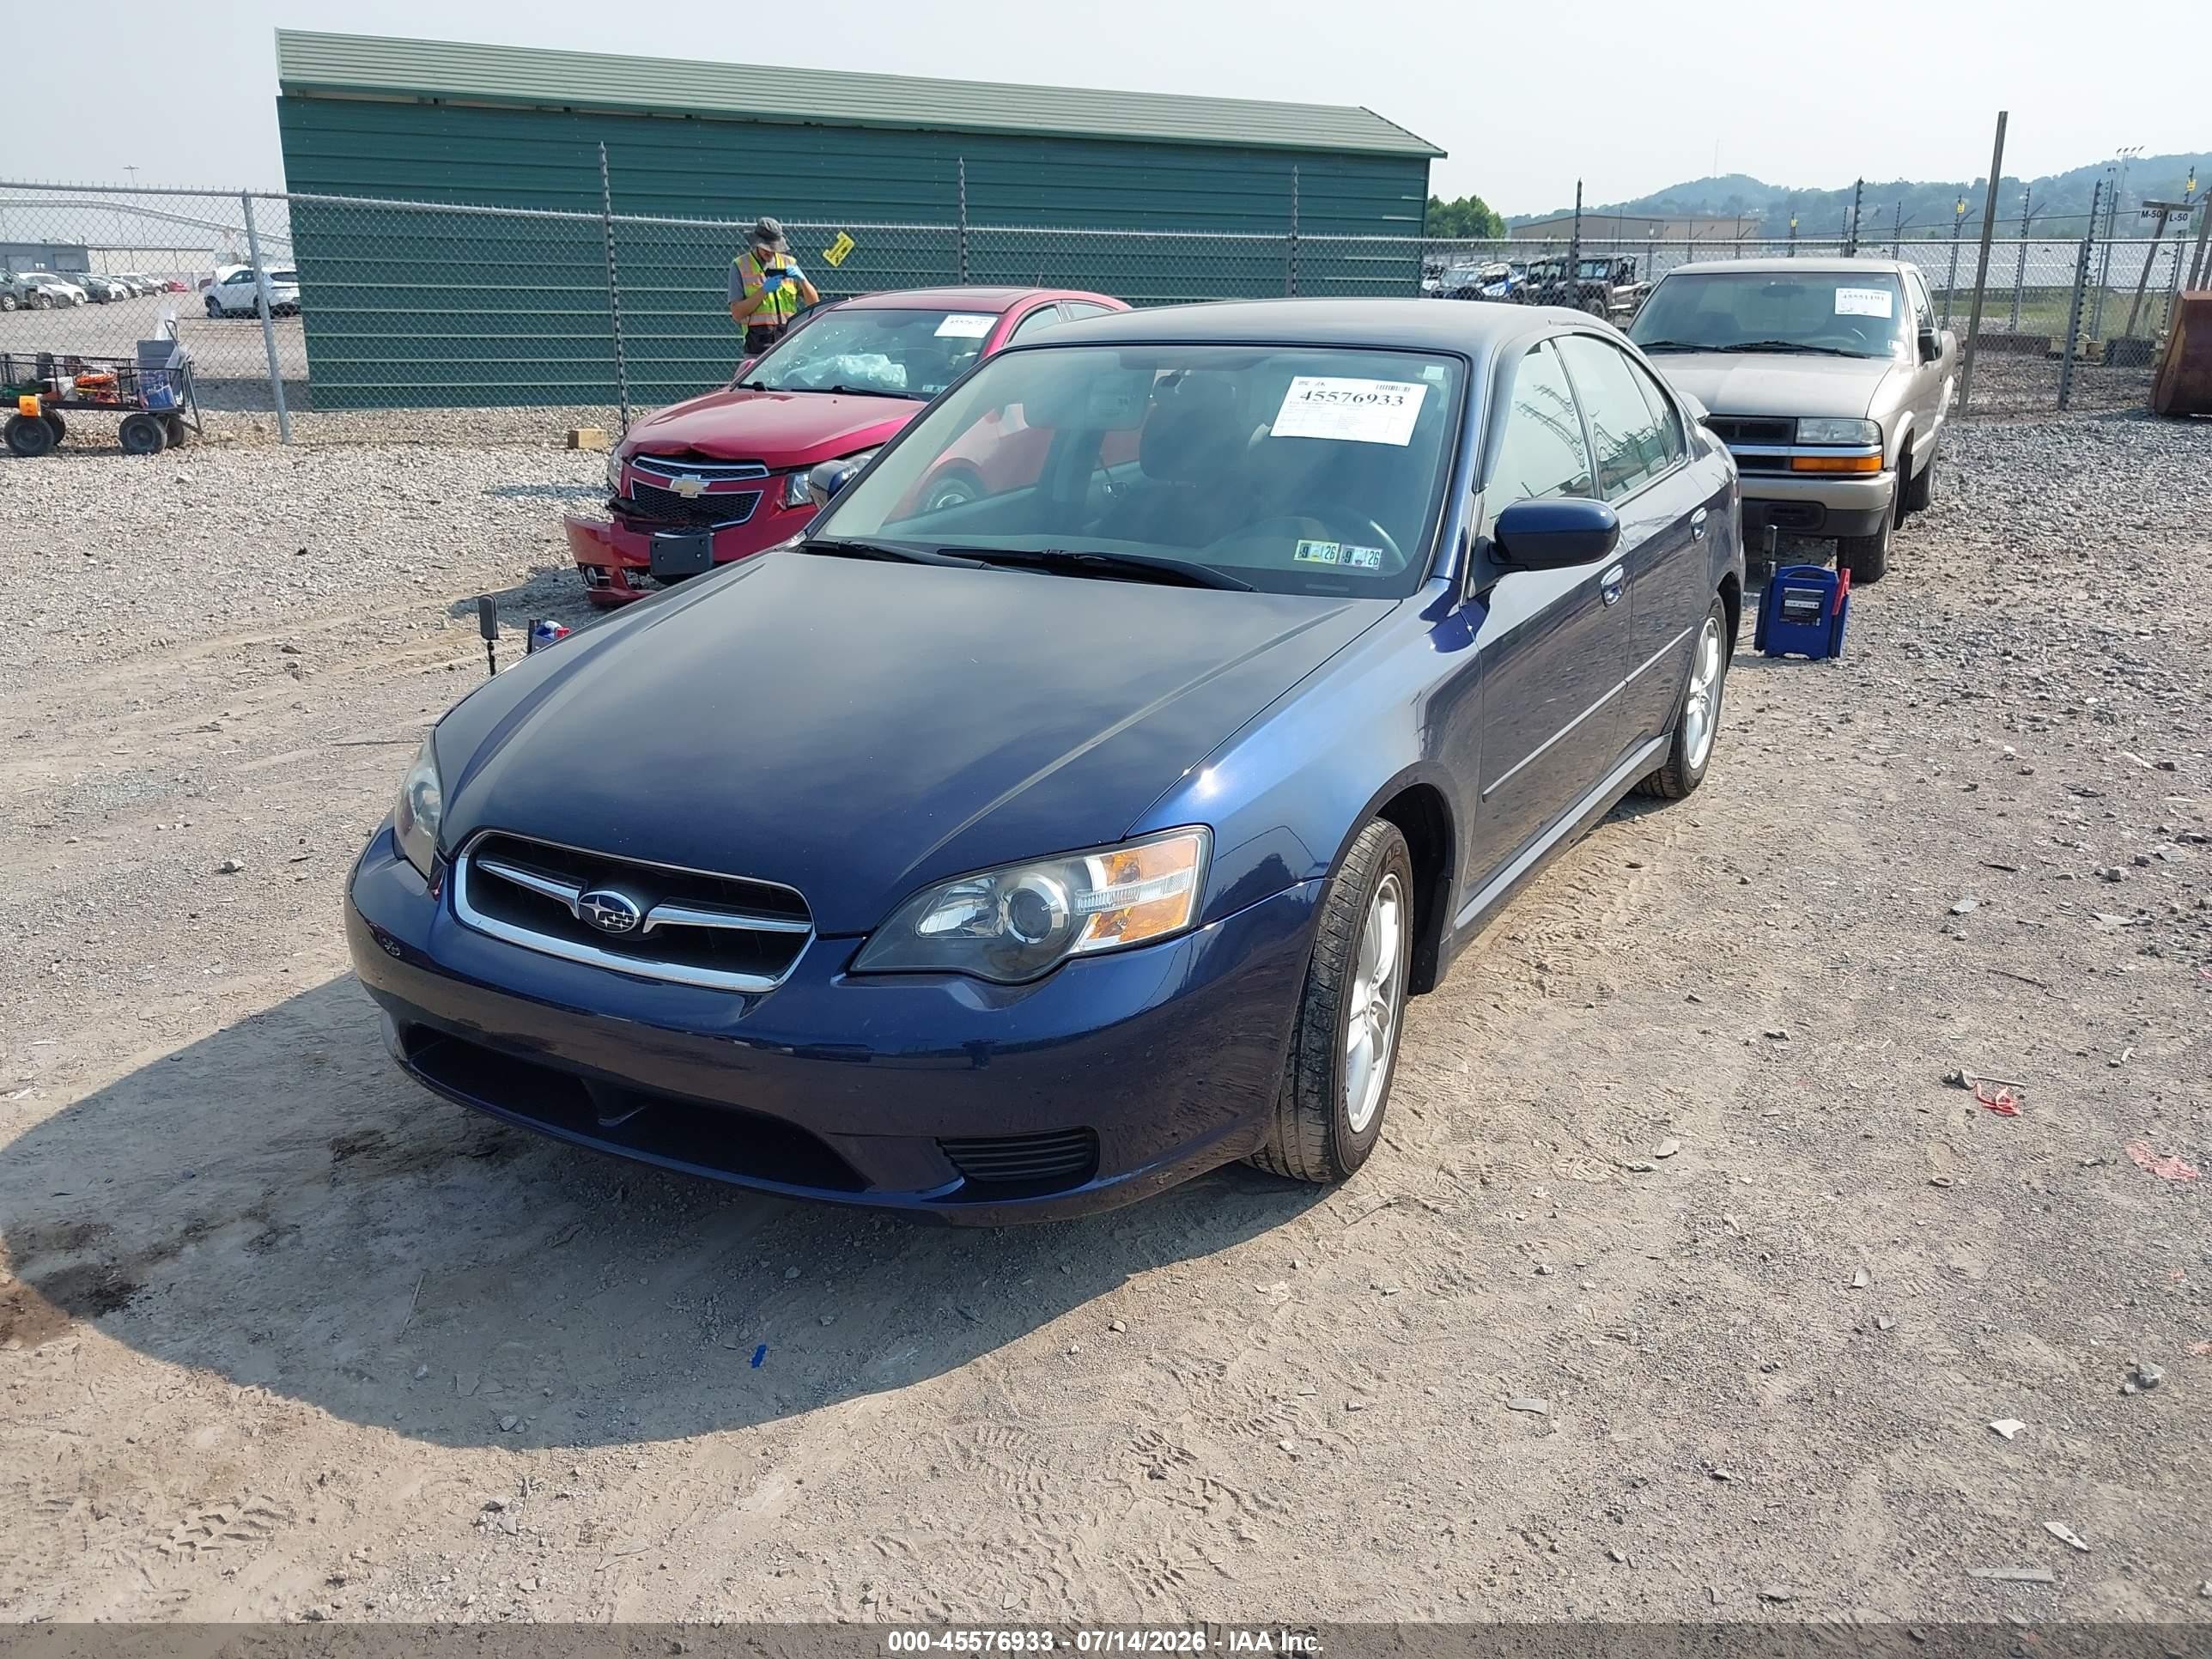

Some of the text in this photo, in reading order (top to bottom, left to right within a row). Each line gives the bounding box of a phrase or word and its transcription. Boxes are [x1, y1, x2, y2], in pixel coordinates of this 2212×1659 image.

[2169, 213, 2188, 222] L-50
[1299, 390, 1404, 406] 45576933
[1324, 545, 1337, 560] 26
[1368, 550, 1380, 565] 26
